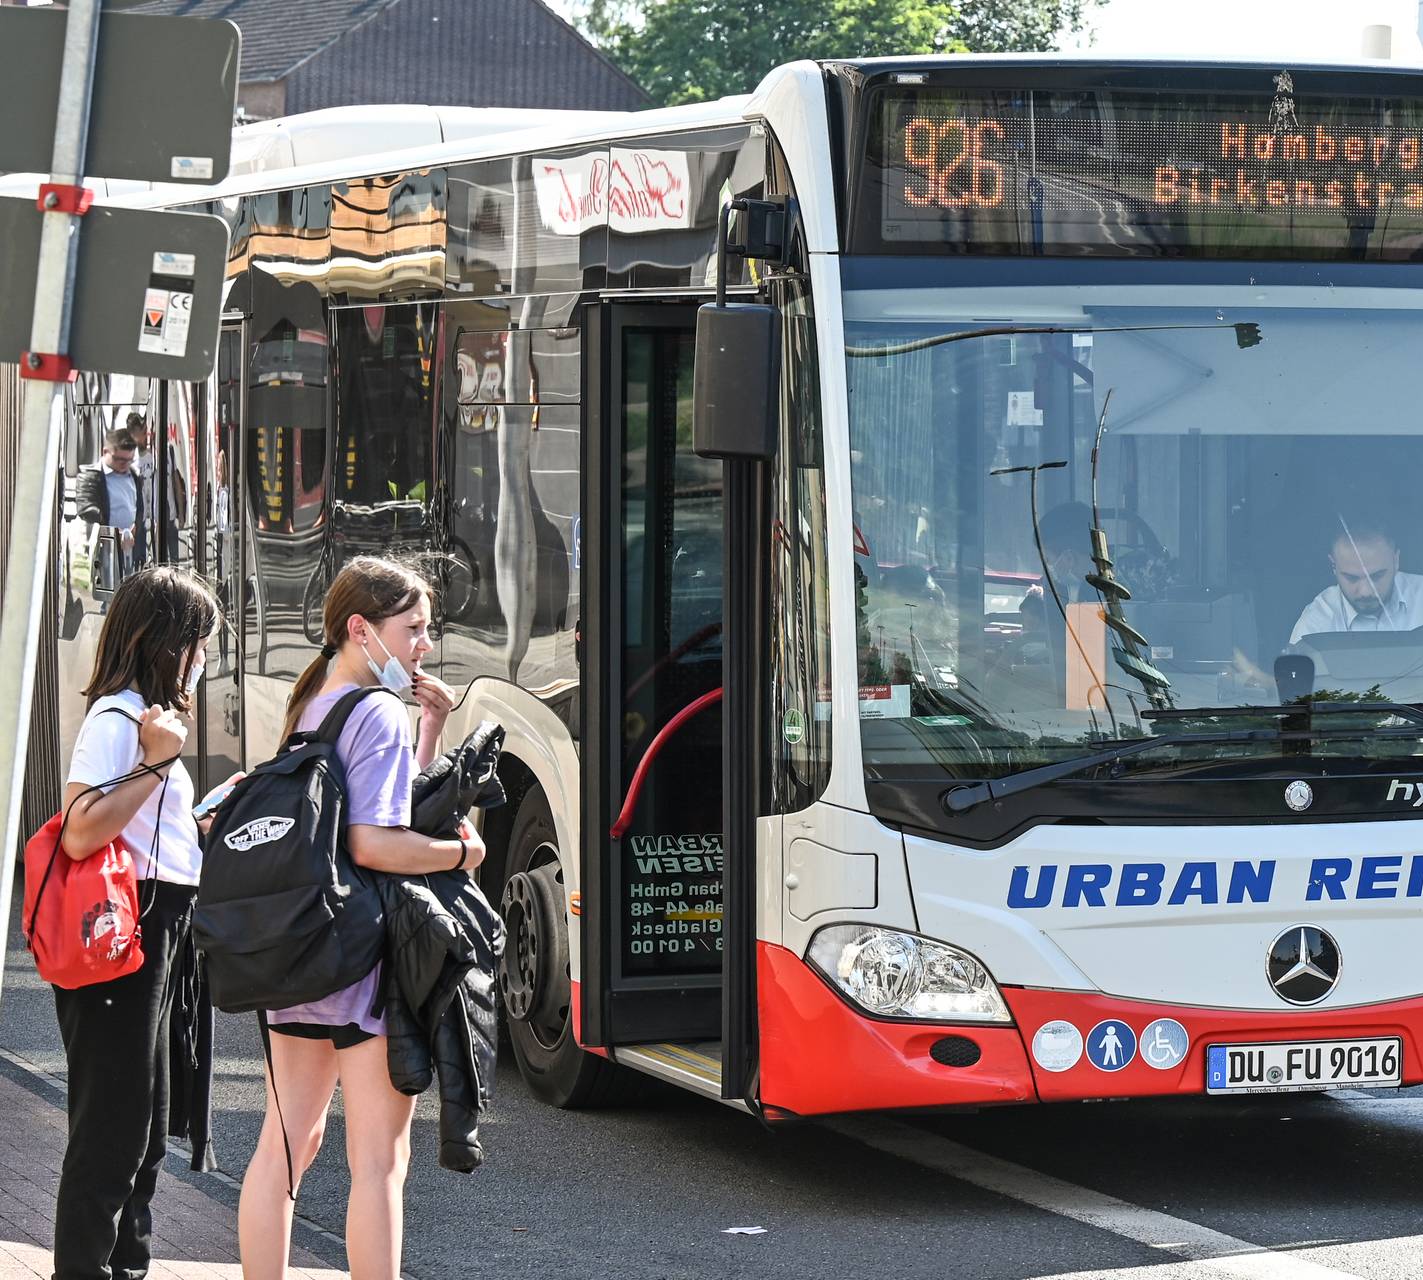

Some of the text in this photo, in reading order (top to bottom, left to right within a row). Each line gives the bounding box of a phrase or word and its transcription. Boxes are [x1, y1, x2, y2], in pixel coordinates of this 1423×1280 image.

[904, 117, 1005, 207] 926
[1221, 121, 1422, 171] Homberg
[249, 828, 267, 841] THE
[1006, 859, 1277, 909] URBAN
[1213, 1072, 1221, 1082] D
[1228, 1044, 1398, 1083] DU FU 9016
